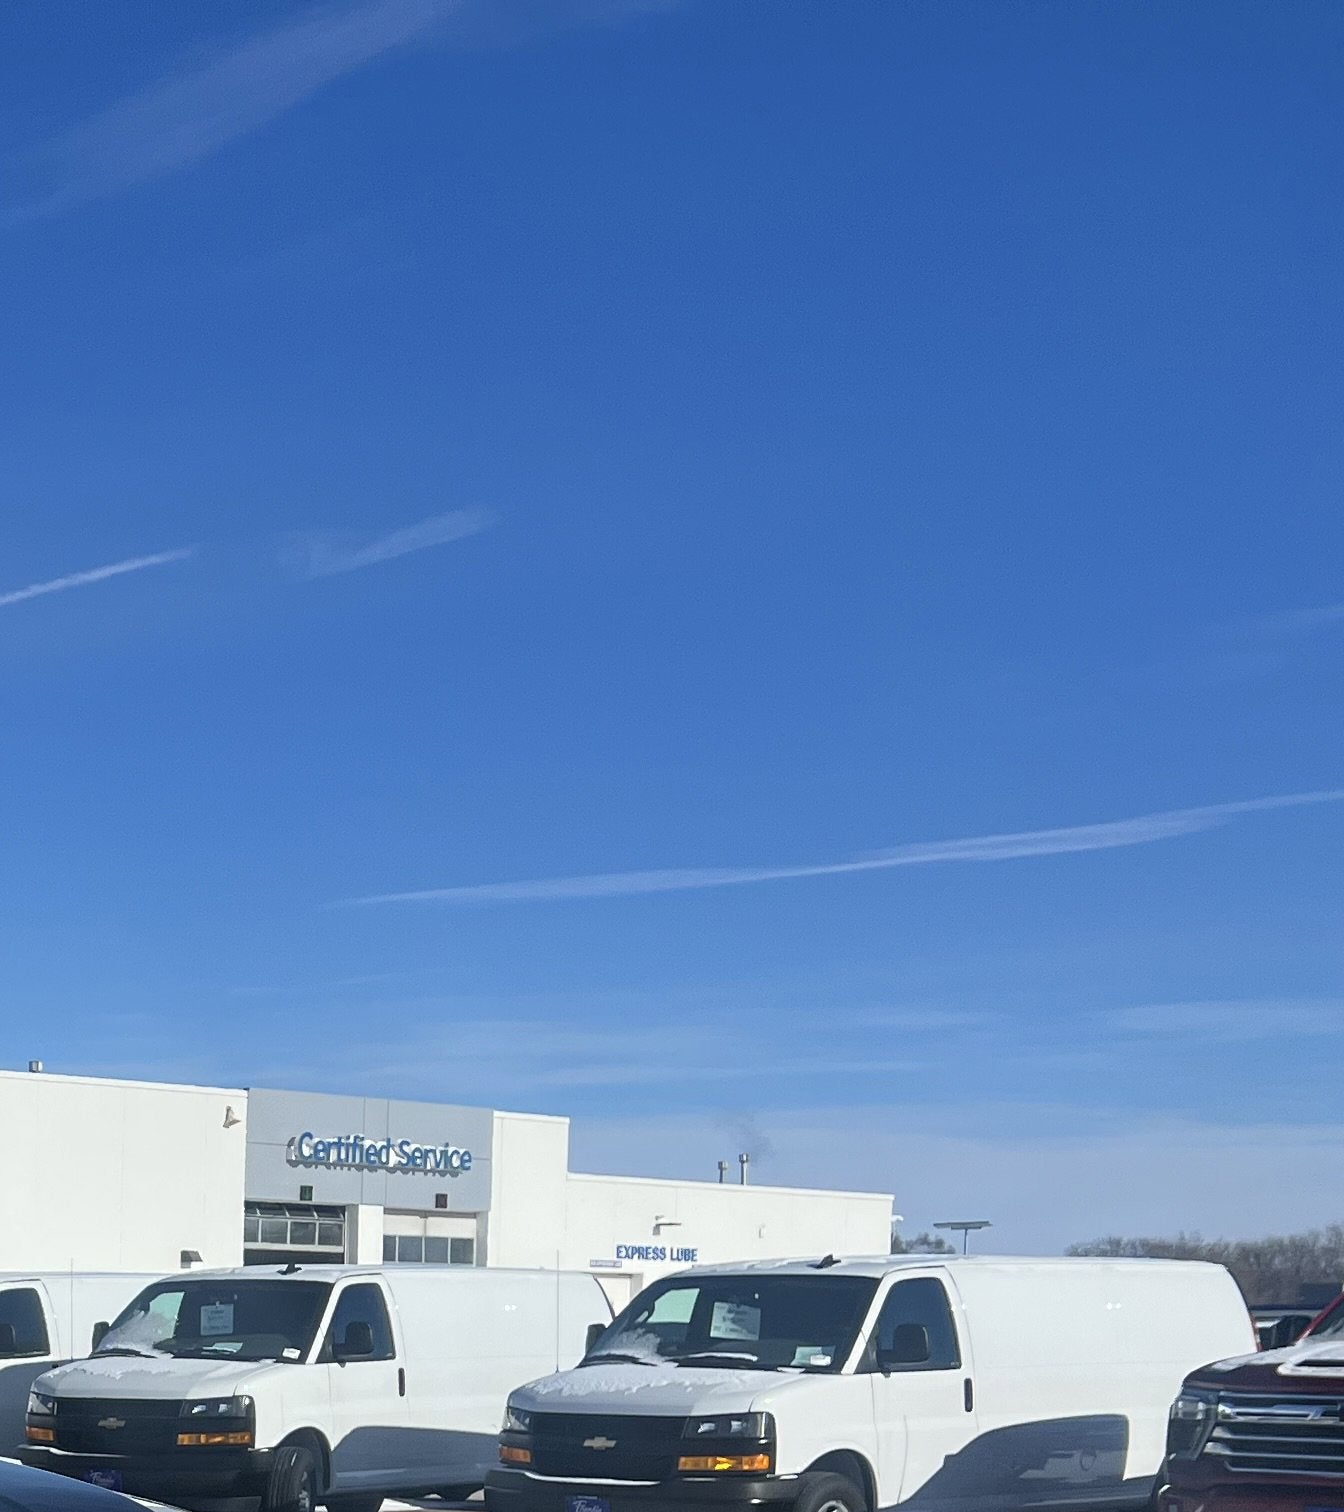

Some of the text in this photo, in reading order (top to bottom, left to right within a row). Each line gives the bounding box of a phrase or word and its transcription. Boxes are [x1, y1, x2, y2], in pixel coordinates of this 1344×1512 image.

[298, 1131, 472, 1171] Certified Service
[616, 1245, 698, 1262] EXPRESS LUBE
